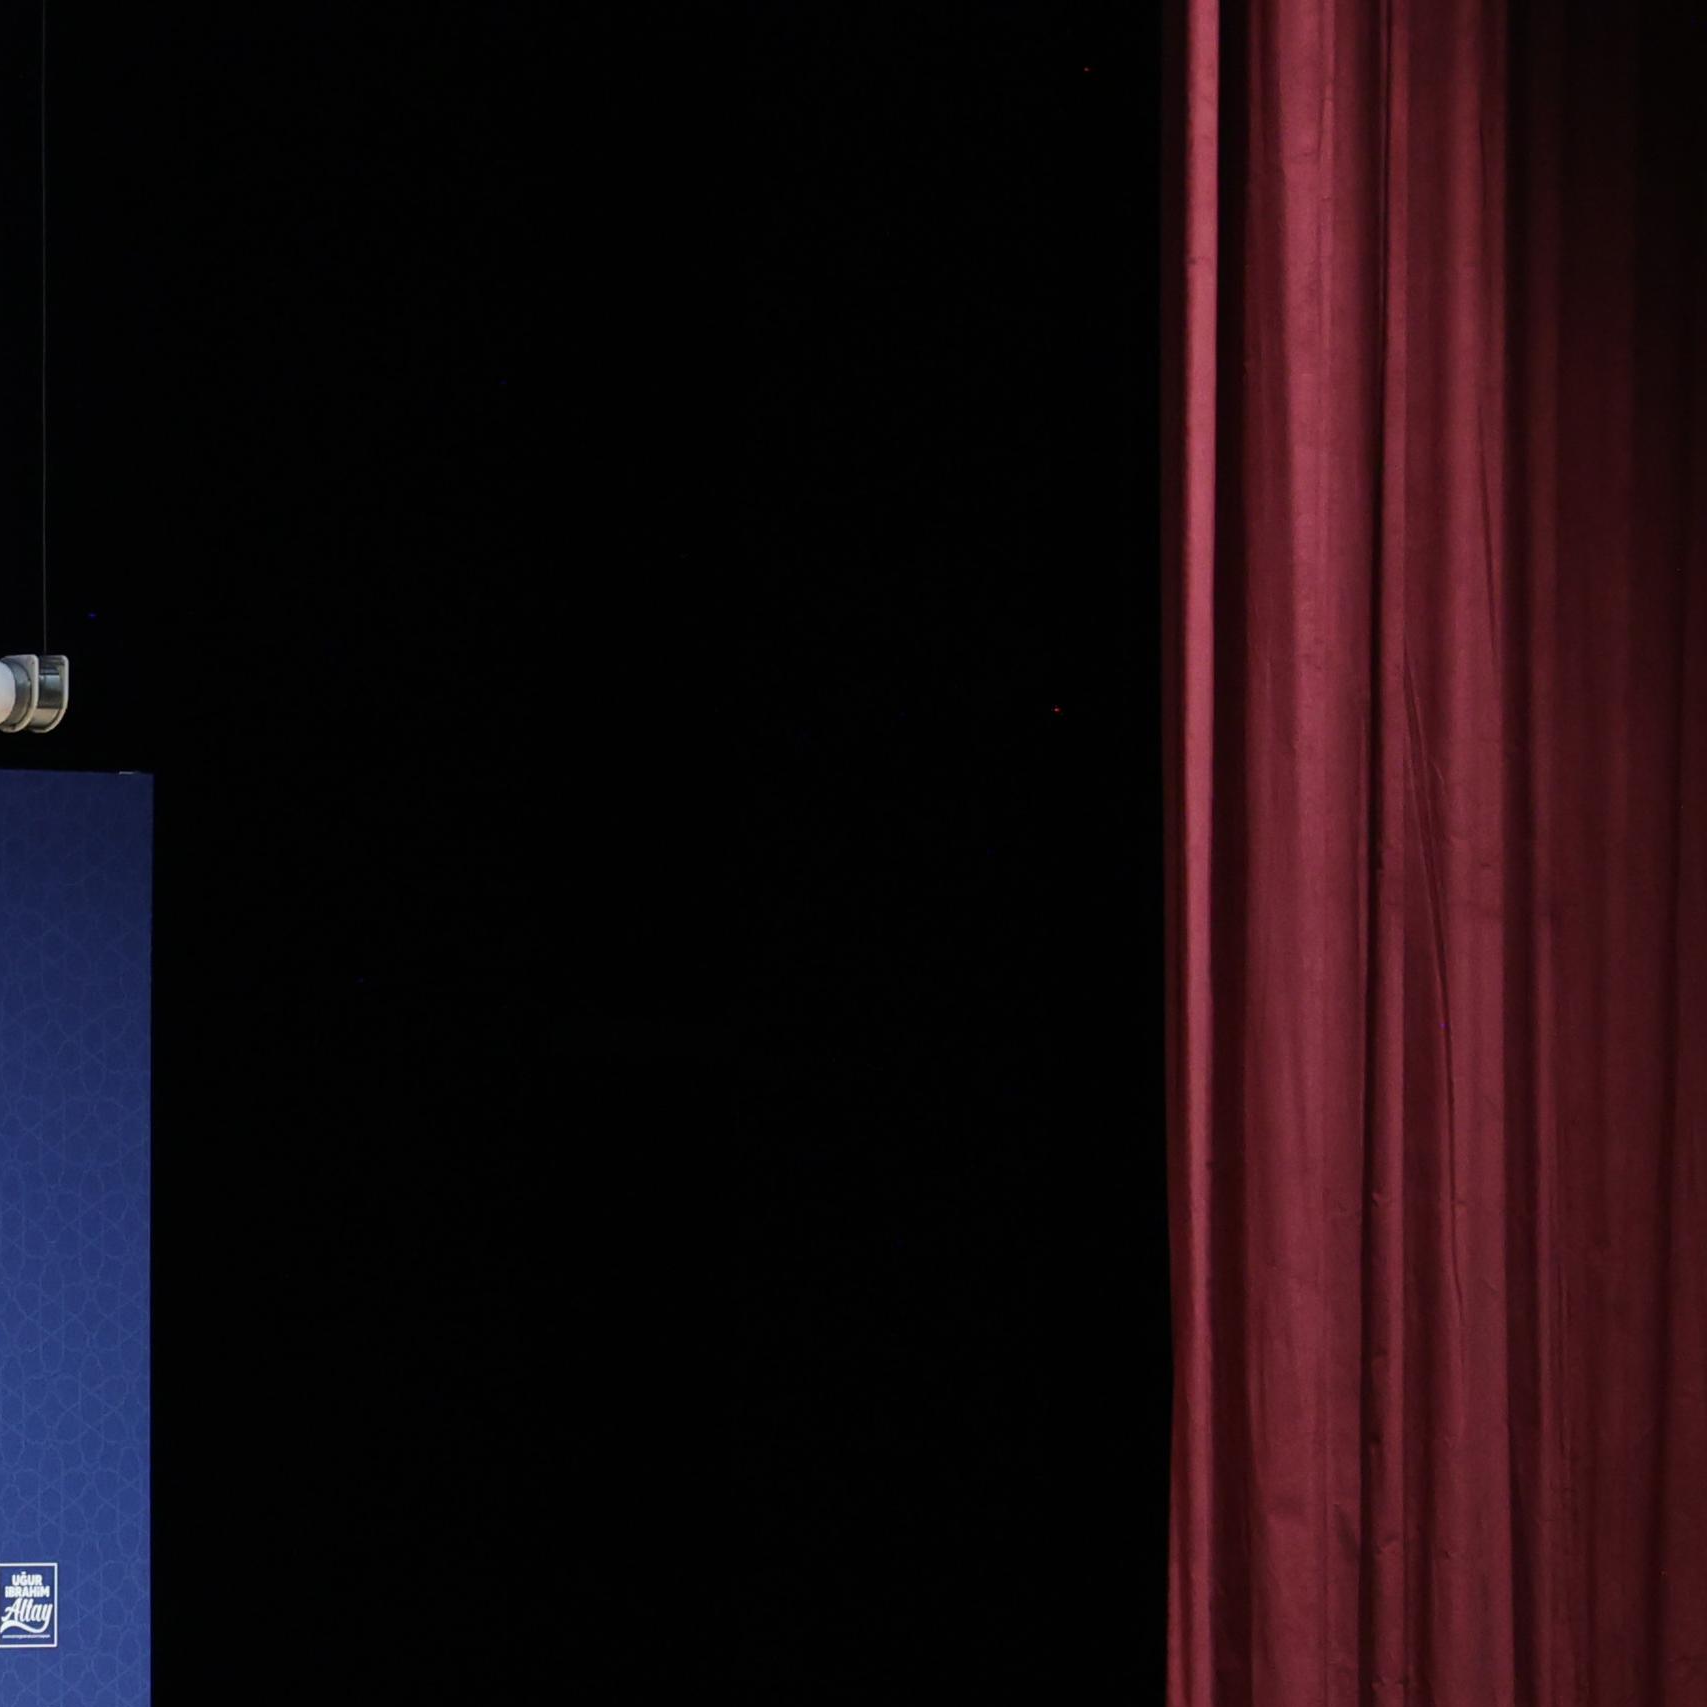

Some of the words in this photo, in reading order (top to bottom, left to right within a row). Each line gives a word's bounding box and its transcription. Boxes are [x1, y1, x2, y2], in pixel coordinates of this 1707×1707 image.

[12, 1572, 42, 1586] UĞUR
[5, 1586, 49, 1598] İBRAHİM
[0, 1597, 53, 1633] Altay
